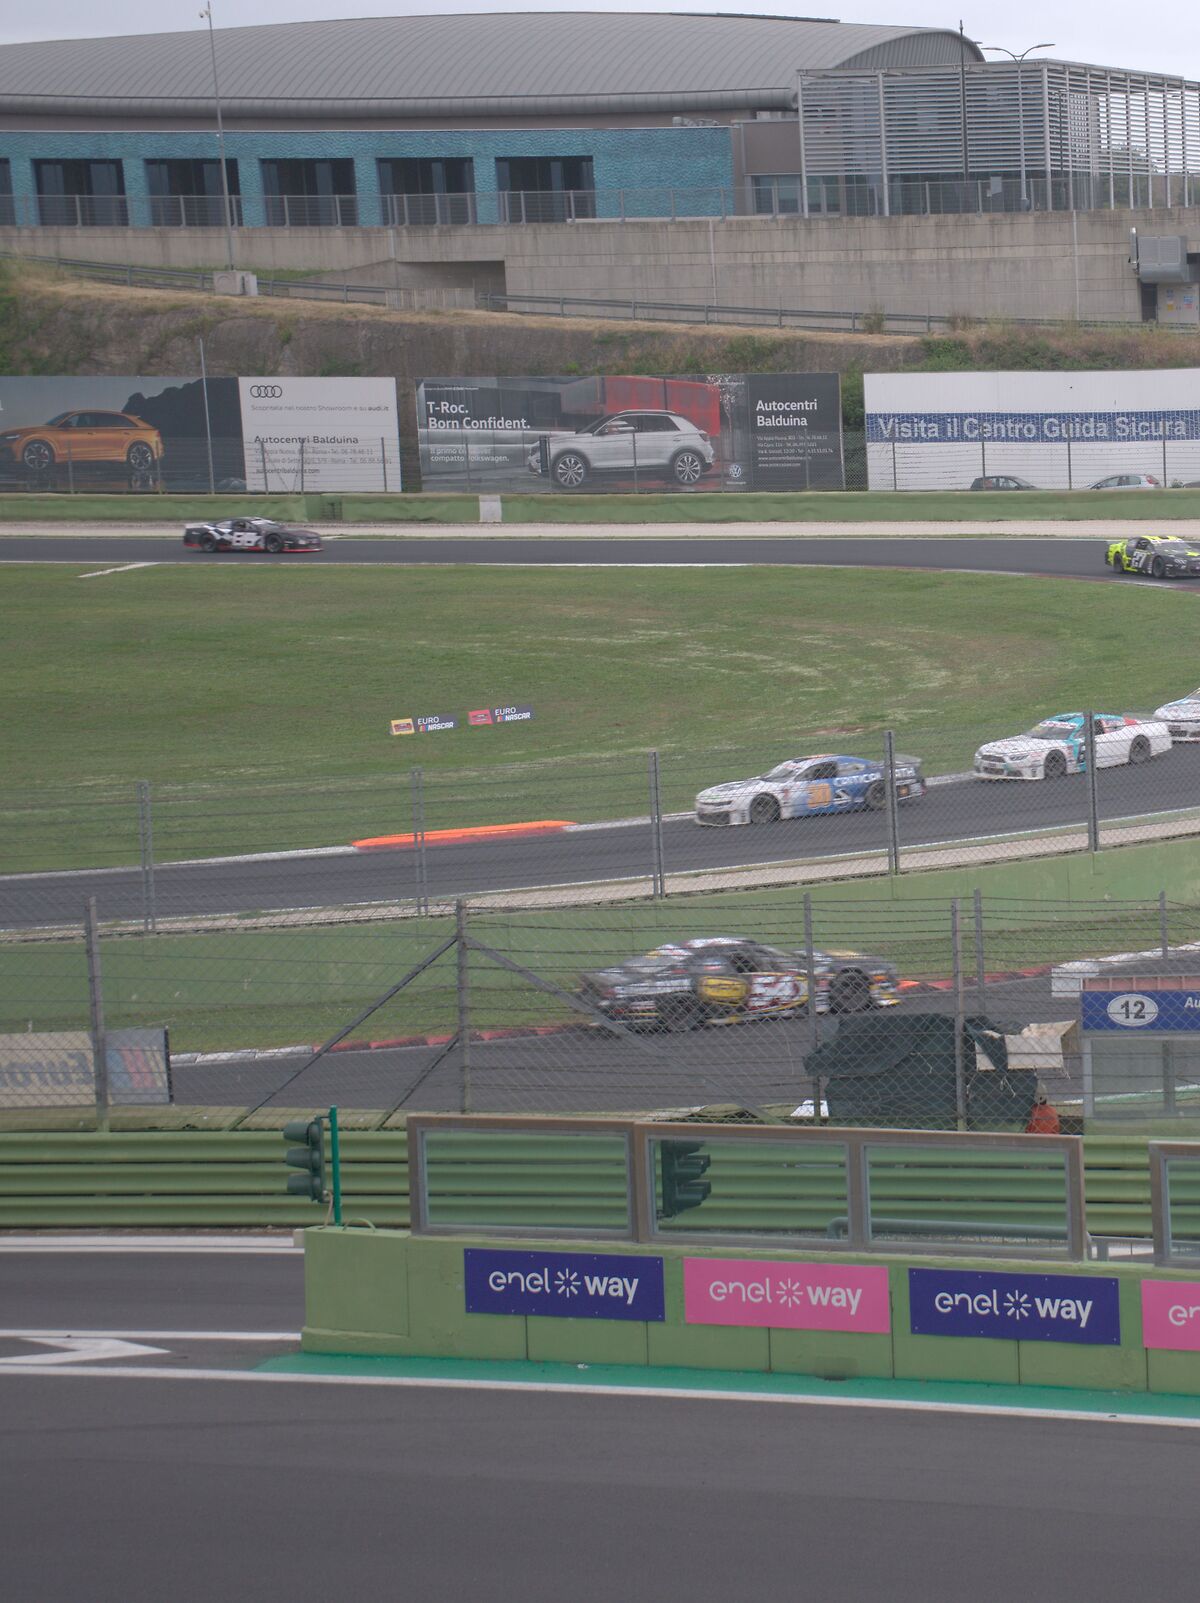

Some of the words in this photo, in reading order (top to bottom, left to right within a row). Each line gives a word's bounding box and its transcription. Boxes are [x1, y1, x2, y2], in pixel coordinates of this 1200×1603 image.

[426, 402, 468, 414] T-Roc.
[756, 399, 818, 411] Autocentri
[428, 418, 459, 429] Born
[462, 417, 530, 429] Confident.
[757, 415, 808, 426] Balduina
[878, 418, 939, 438] Visita
[947, 418, 958, 438] il
[963, 417, 1036, 438] Centro
[1043, 417, 1108, 438] Guida
[1116, 416, 1186, 436] Sicura
[254, 435, 310, 444] Autocentri
[313, 435, 359, 444] Balduina
[494, 707, 517, 716] EURO
[505, 712, 531, 721] NASCAR
[418, 716, 439, 726] EURO
[428, 722, 454, 732] NASCAR
[1120, 1000, 1146, 1020] 12
[488, 1268, 550, 1294] enel
[583, 1277, 639, 1305] way
[709, 1278, 772, 1304] enel
[806, 1286, 862, 1316] way
[934, 1289, 999, 1316] enel
[1034, 1296, 1093, 1328] way
